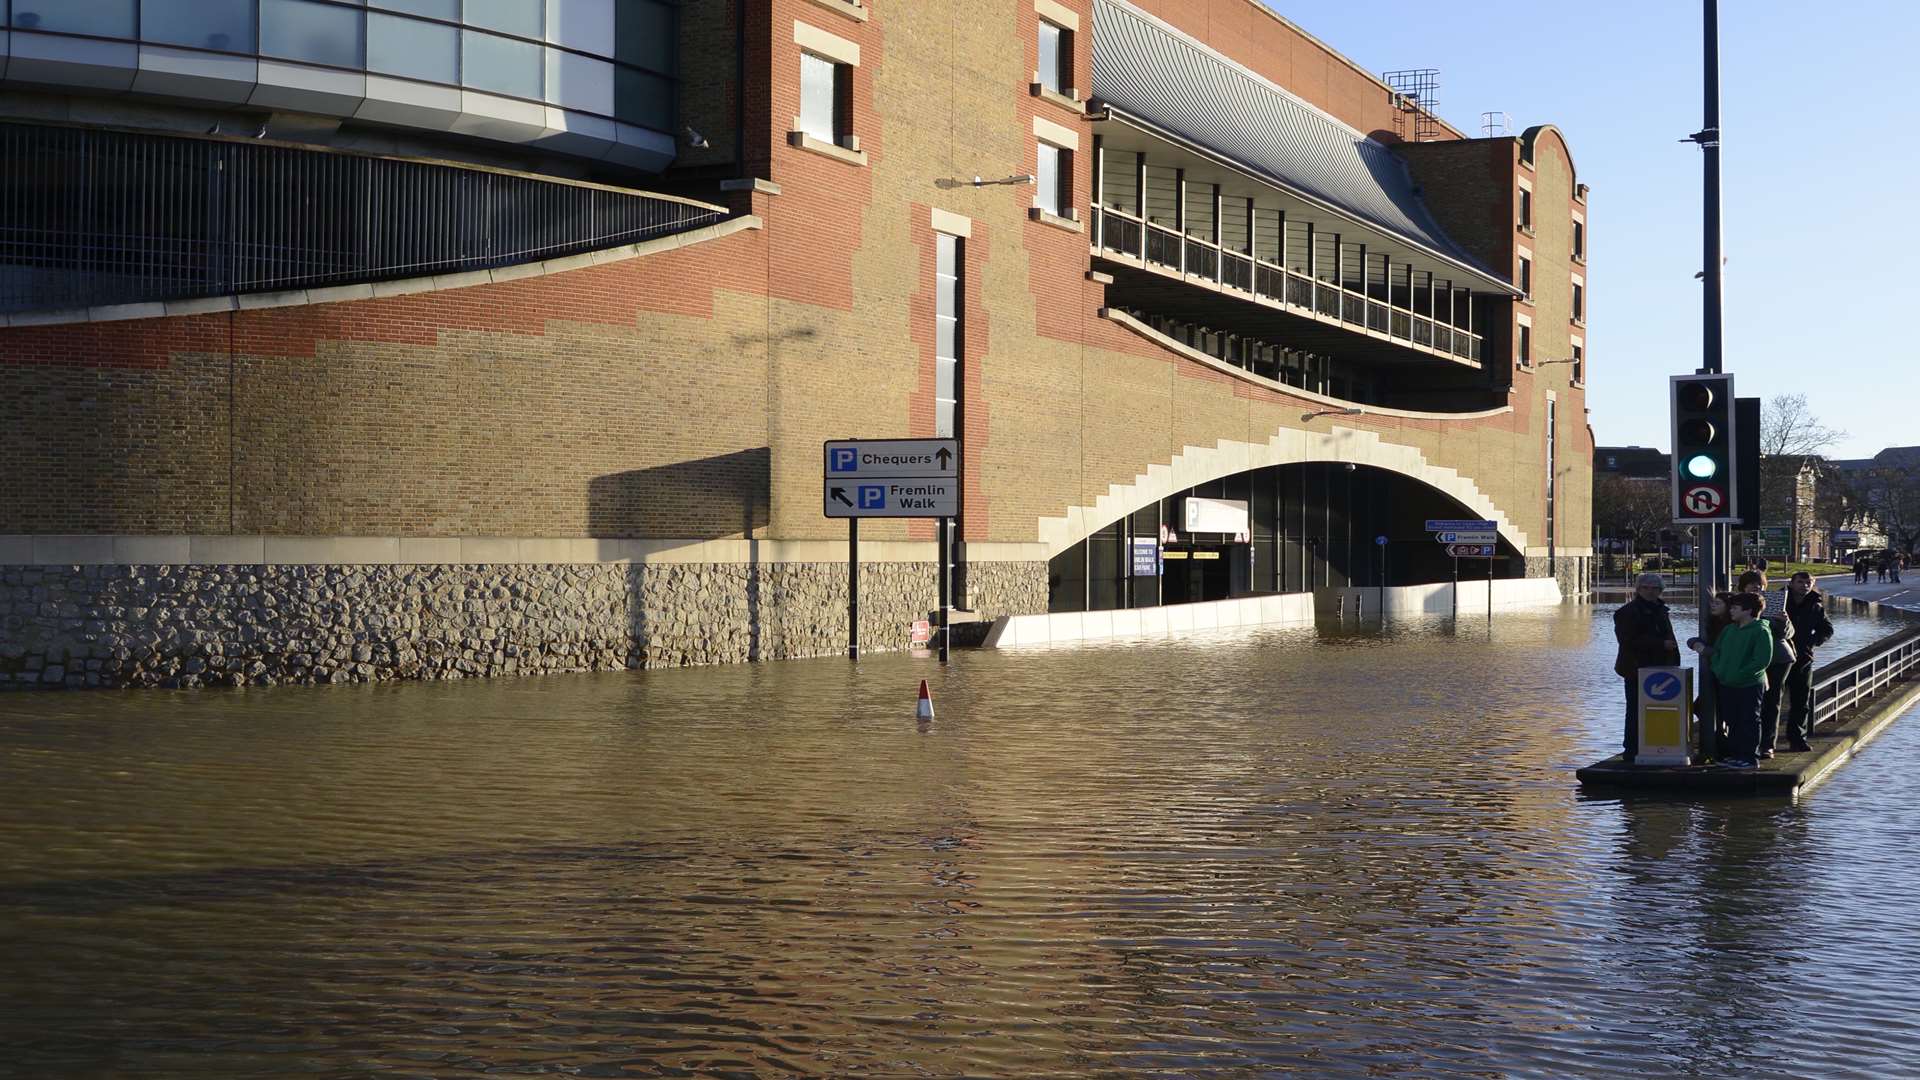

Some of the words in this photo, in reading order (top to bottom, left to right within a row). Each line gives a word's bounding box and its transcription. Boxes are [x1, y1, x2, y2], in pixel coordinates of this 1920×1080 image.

[837, 450, 854, 469] P
[862, 454, 932, 466] Chequers
[865, 488, 881, 507] P
[890, 485, 945, 496] Fremlin
[900, 498, 936, 509] Walk
